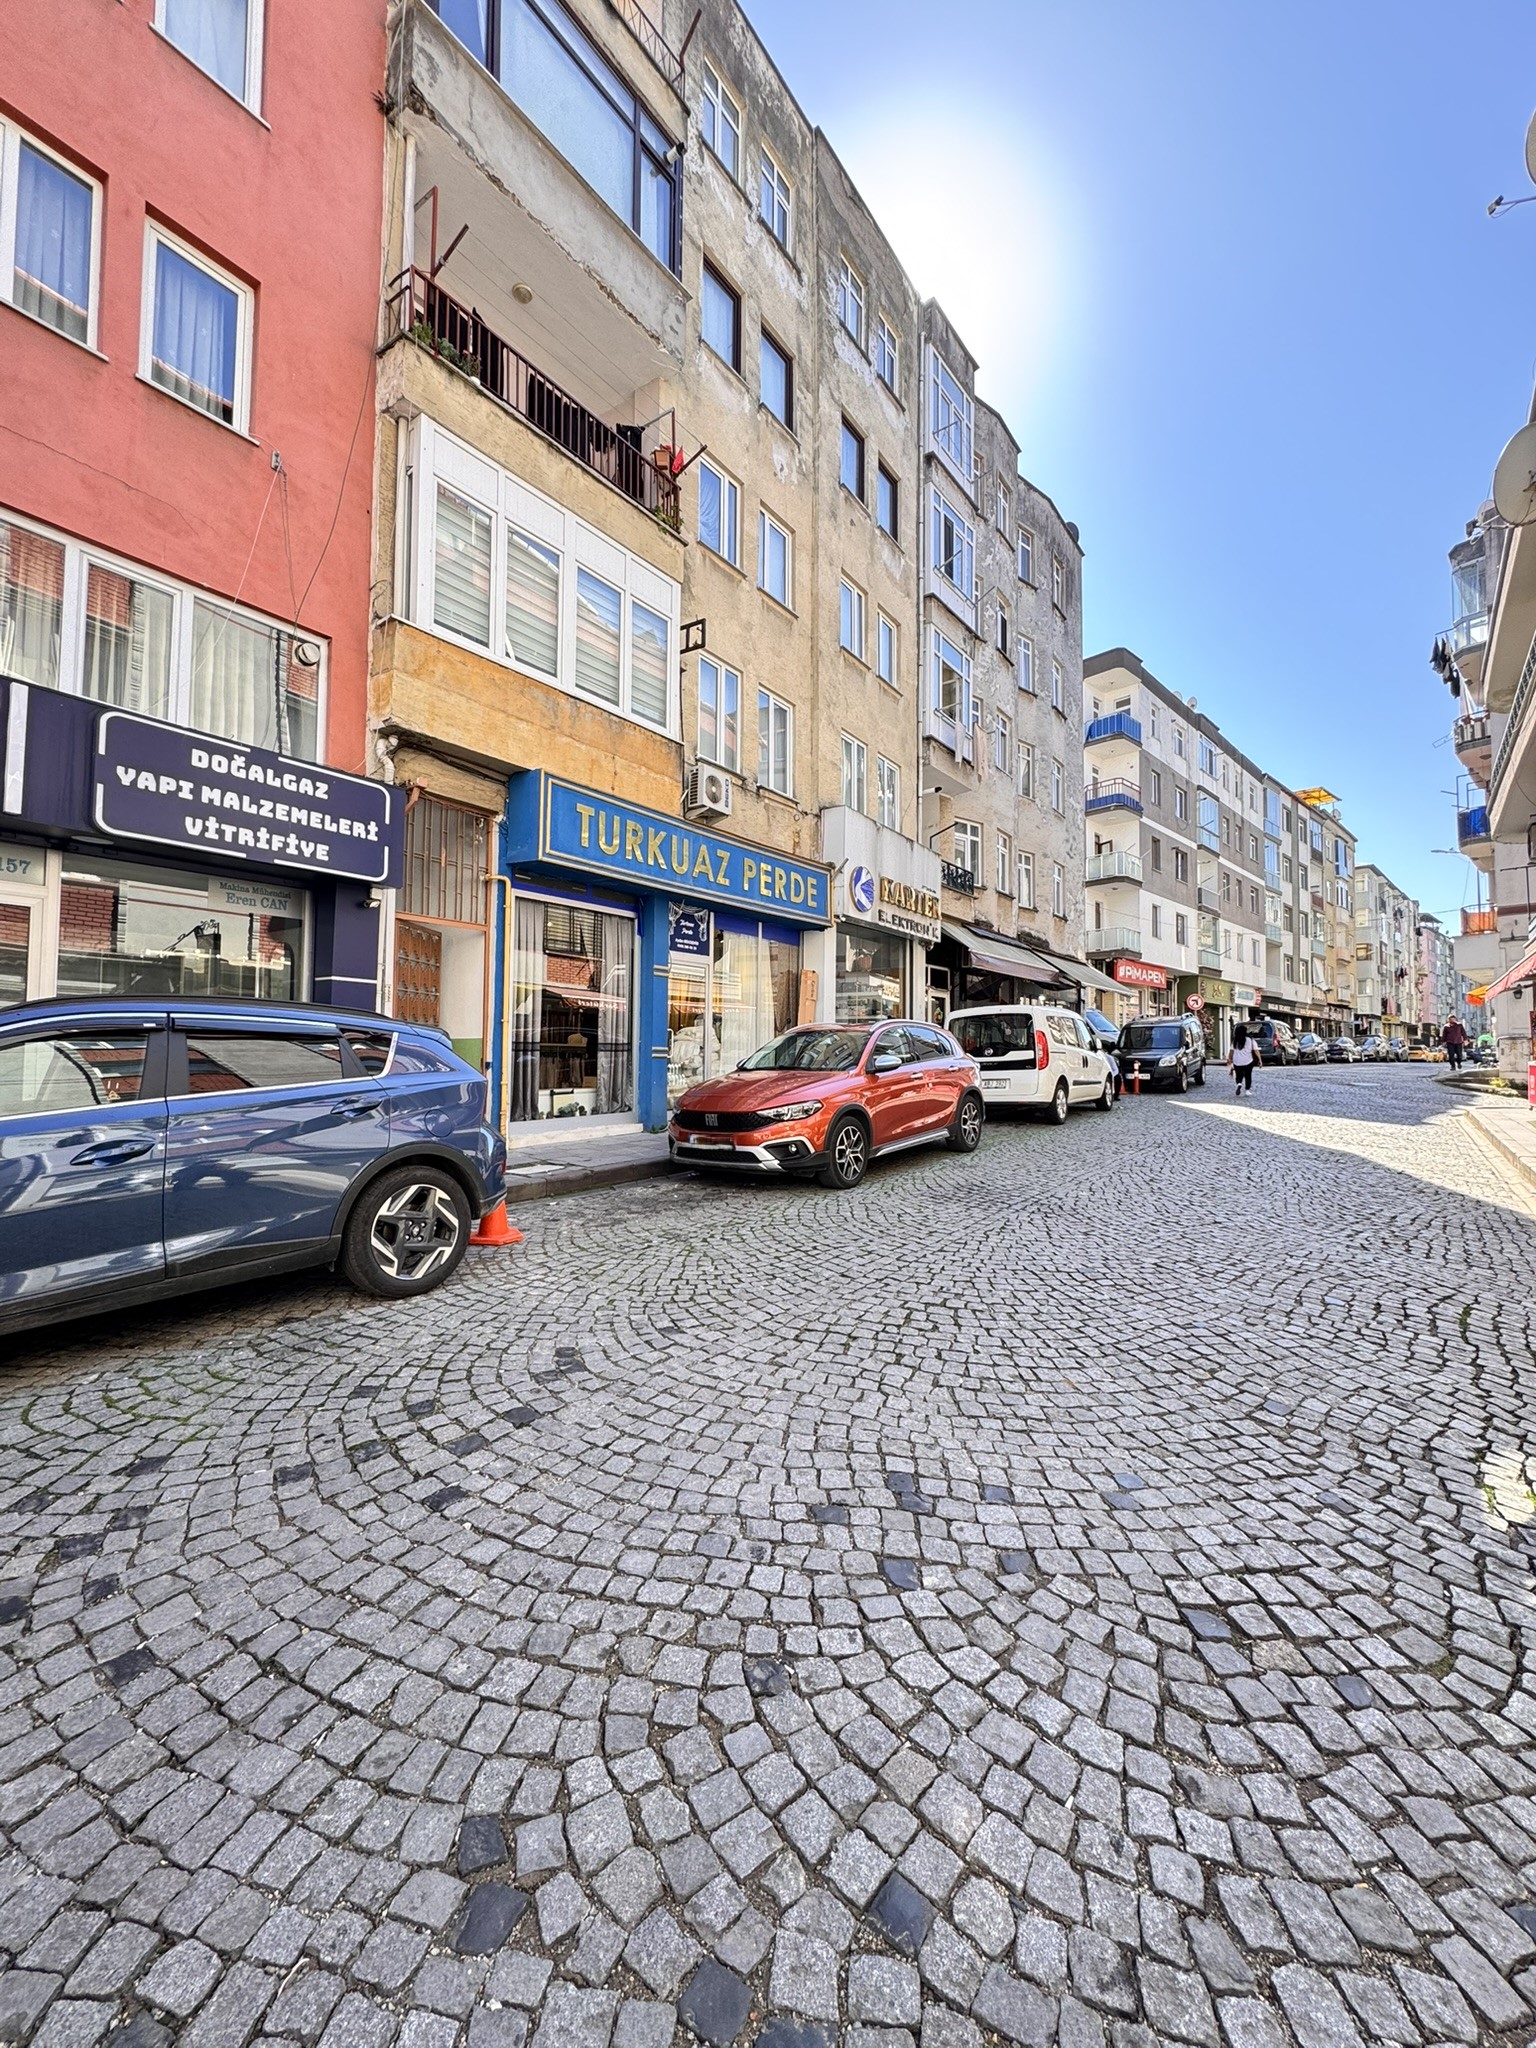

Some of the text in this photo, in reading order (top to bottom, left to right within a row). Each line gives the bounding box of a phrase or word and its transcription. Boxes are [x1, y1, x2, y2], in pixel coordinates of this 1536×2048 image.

[191, 748, 329, 800] DOĞALGAZ
[116, 765, 379, 842] YAPI MALZEMELERİ
[185, 815, 330, 861] VİTRİFİYE
[576, 803, 818, 909] TURKUAZ PERDE
[219, 882, 250, 893] Makina
[225, 892, 288, 911] Eren CAN
